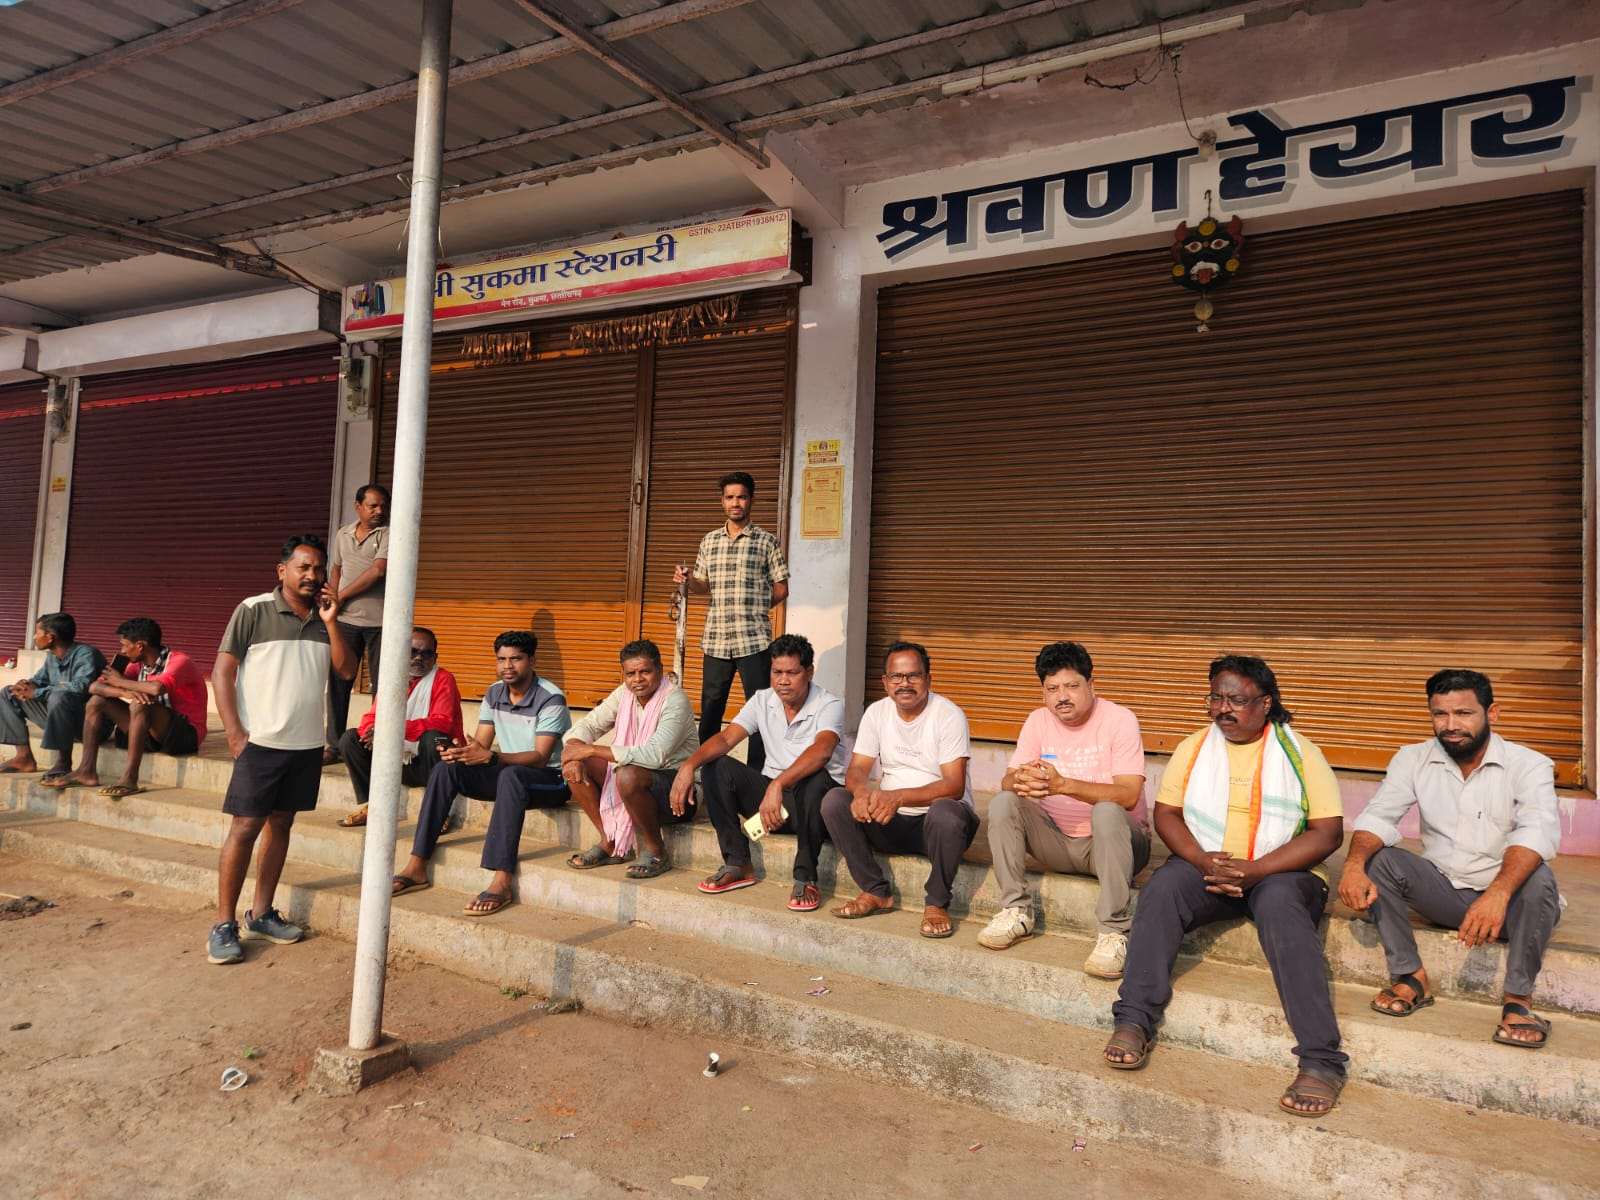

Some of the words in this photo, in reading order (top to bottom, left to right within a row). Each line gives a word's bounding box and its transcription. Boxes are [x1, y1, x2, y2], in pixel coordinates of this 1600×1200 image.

[876, 144, 1200, 261] श्रवण
[1212, 75, 1577, 202] हेयर
[460, 263, 549, 300] सुकमा
[555, 233, 677, 278] स्टेशनरी
